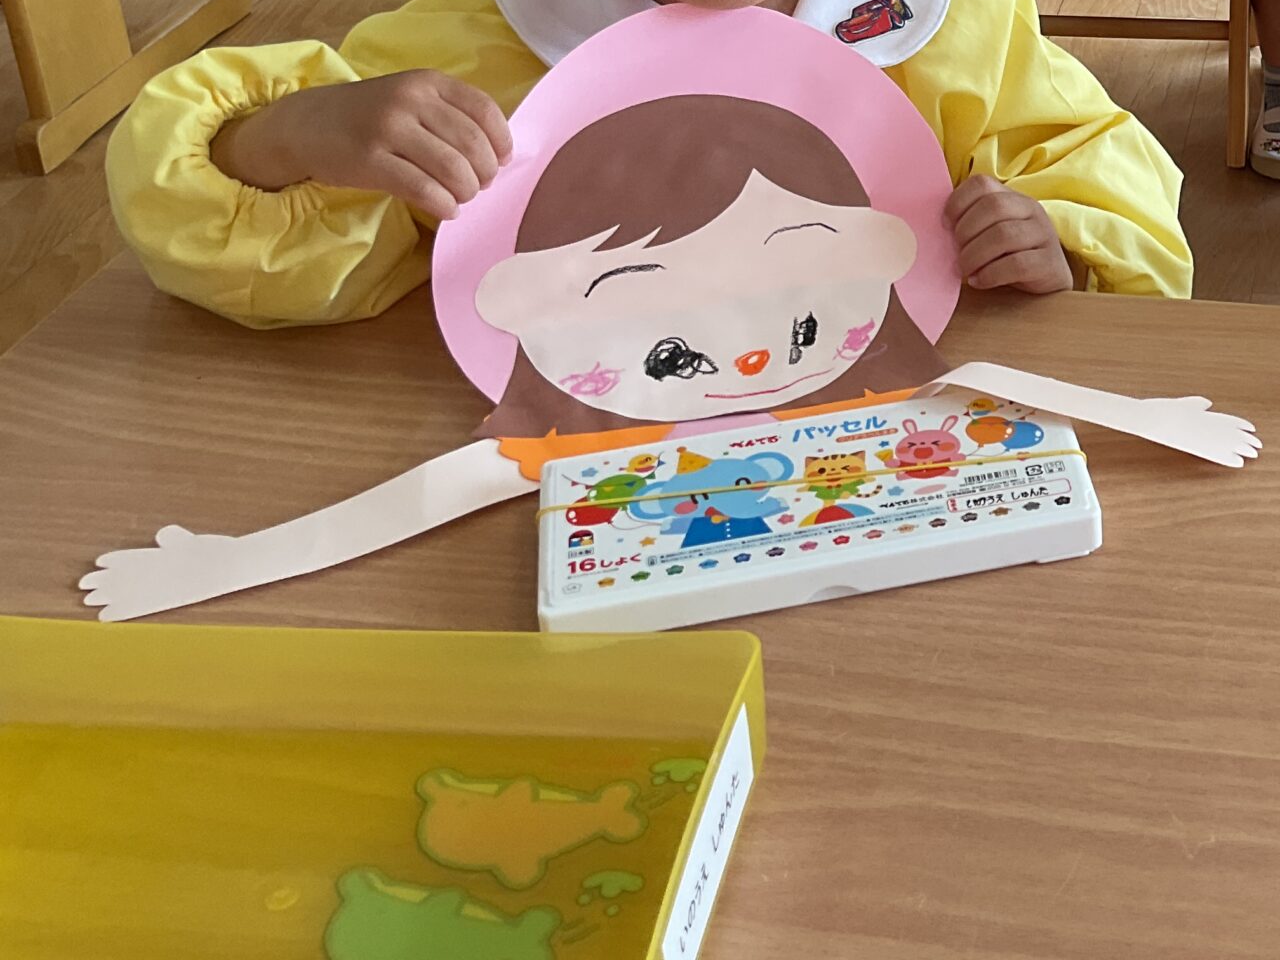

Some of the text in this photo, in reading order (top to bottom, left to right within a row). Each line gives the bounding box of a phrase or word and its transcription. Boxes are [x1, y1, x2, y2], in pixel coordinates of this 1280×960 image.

[793, 416, 888, 443] パッセル
[679, 771, 740, 954] いのうえ しゅんた
